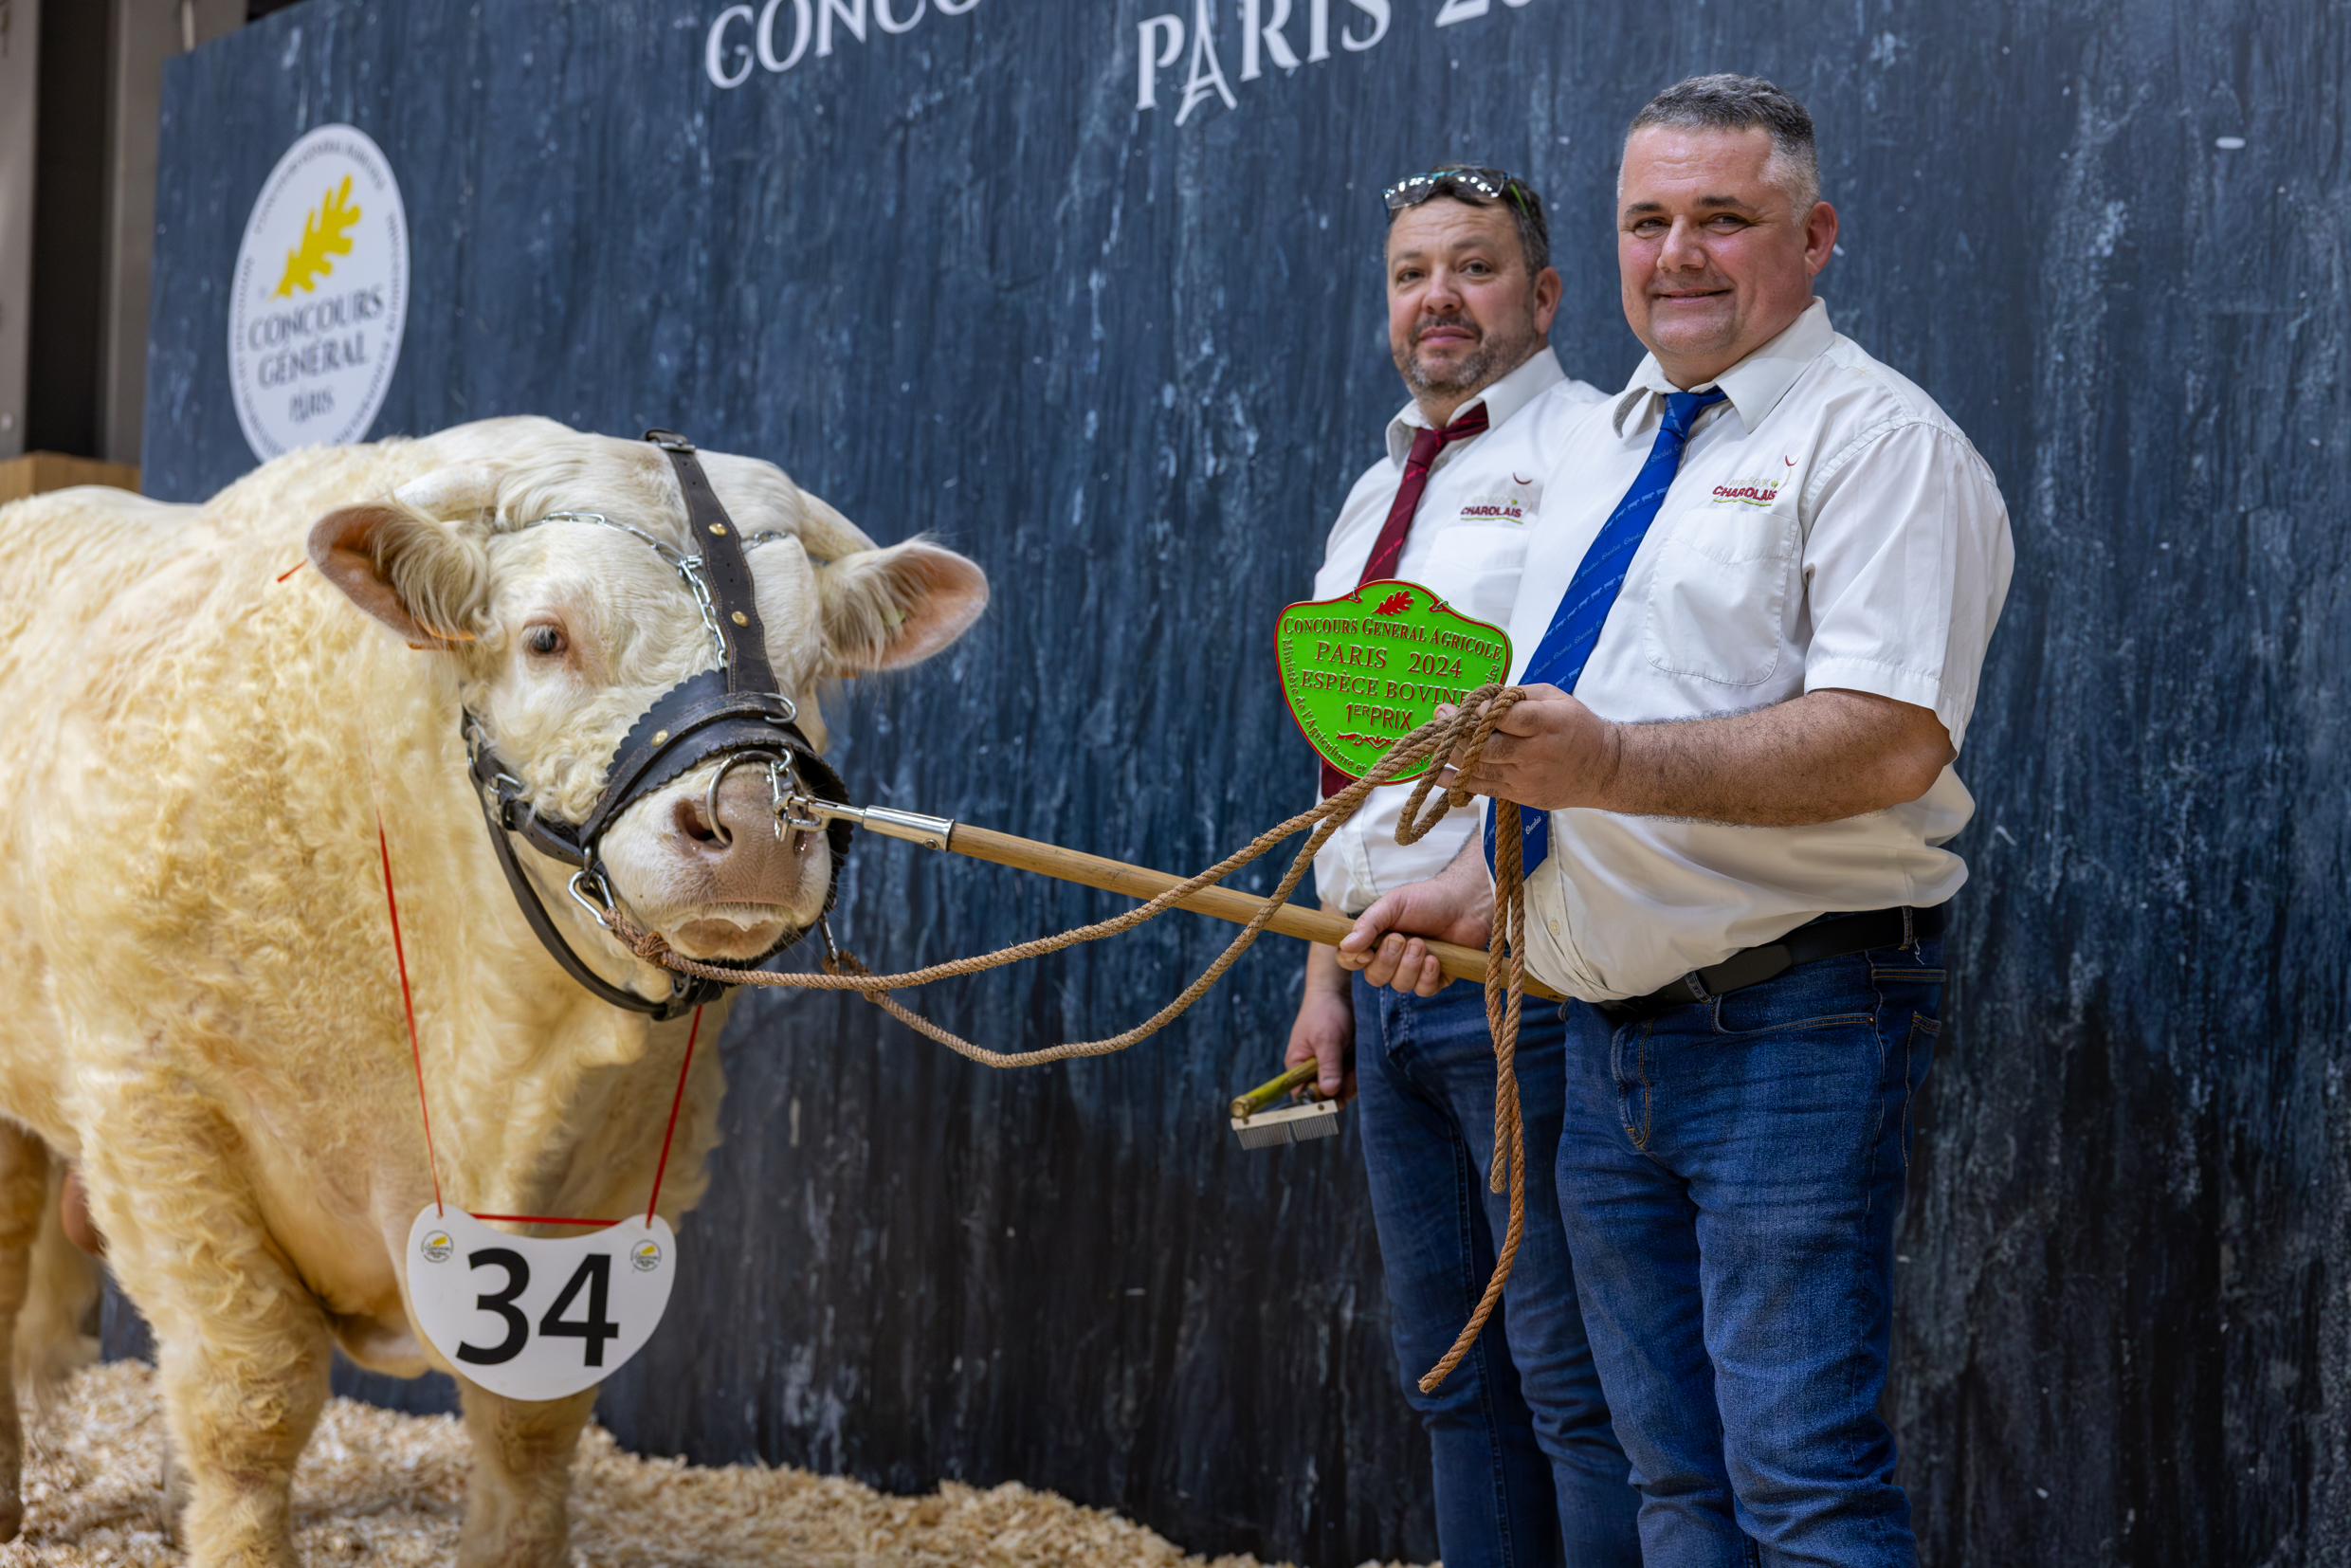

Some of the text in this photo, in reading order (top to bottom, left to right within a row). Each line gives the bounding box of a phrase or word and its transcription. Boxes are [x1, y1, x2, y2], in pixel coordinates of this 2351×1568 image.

[1136, 0, 1392, 126] PARIS
[247, 283, 385, 352] CONCOURS
[1461, 505, 1522, 518] CHAROLAIS
[1712, 485, 1777, 501] CHAROLAIS
[1284, 616, 1503, 661] CONCOURS GENERAL AGRICOLE
[1315, 640, 1462, 679] PARIS 2024
[1282, 636, 1299, 695] Ministère
[1294, 696, 1305, 711] de
[1356, 763, 1367, 774] et
[1300, 669, 1379, 696] ESPÈCE
[455, 1248, 620, 1368] 34
